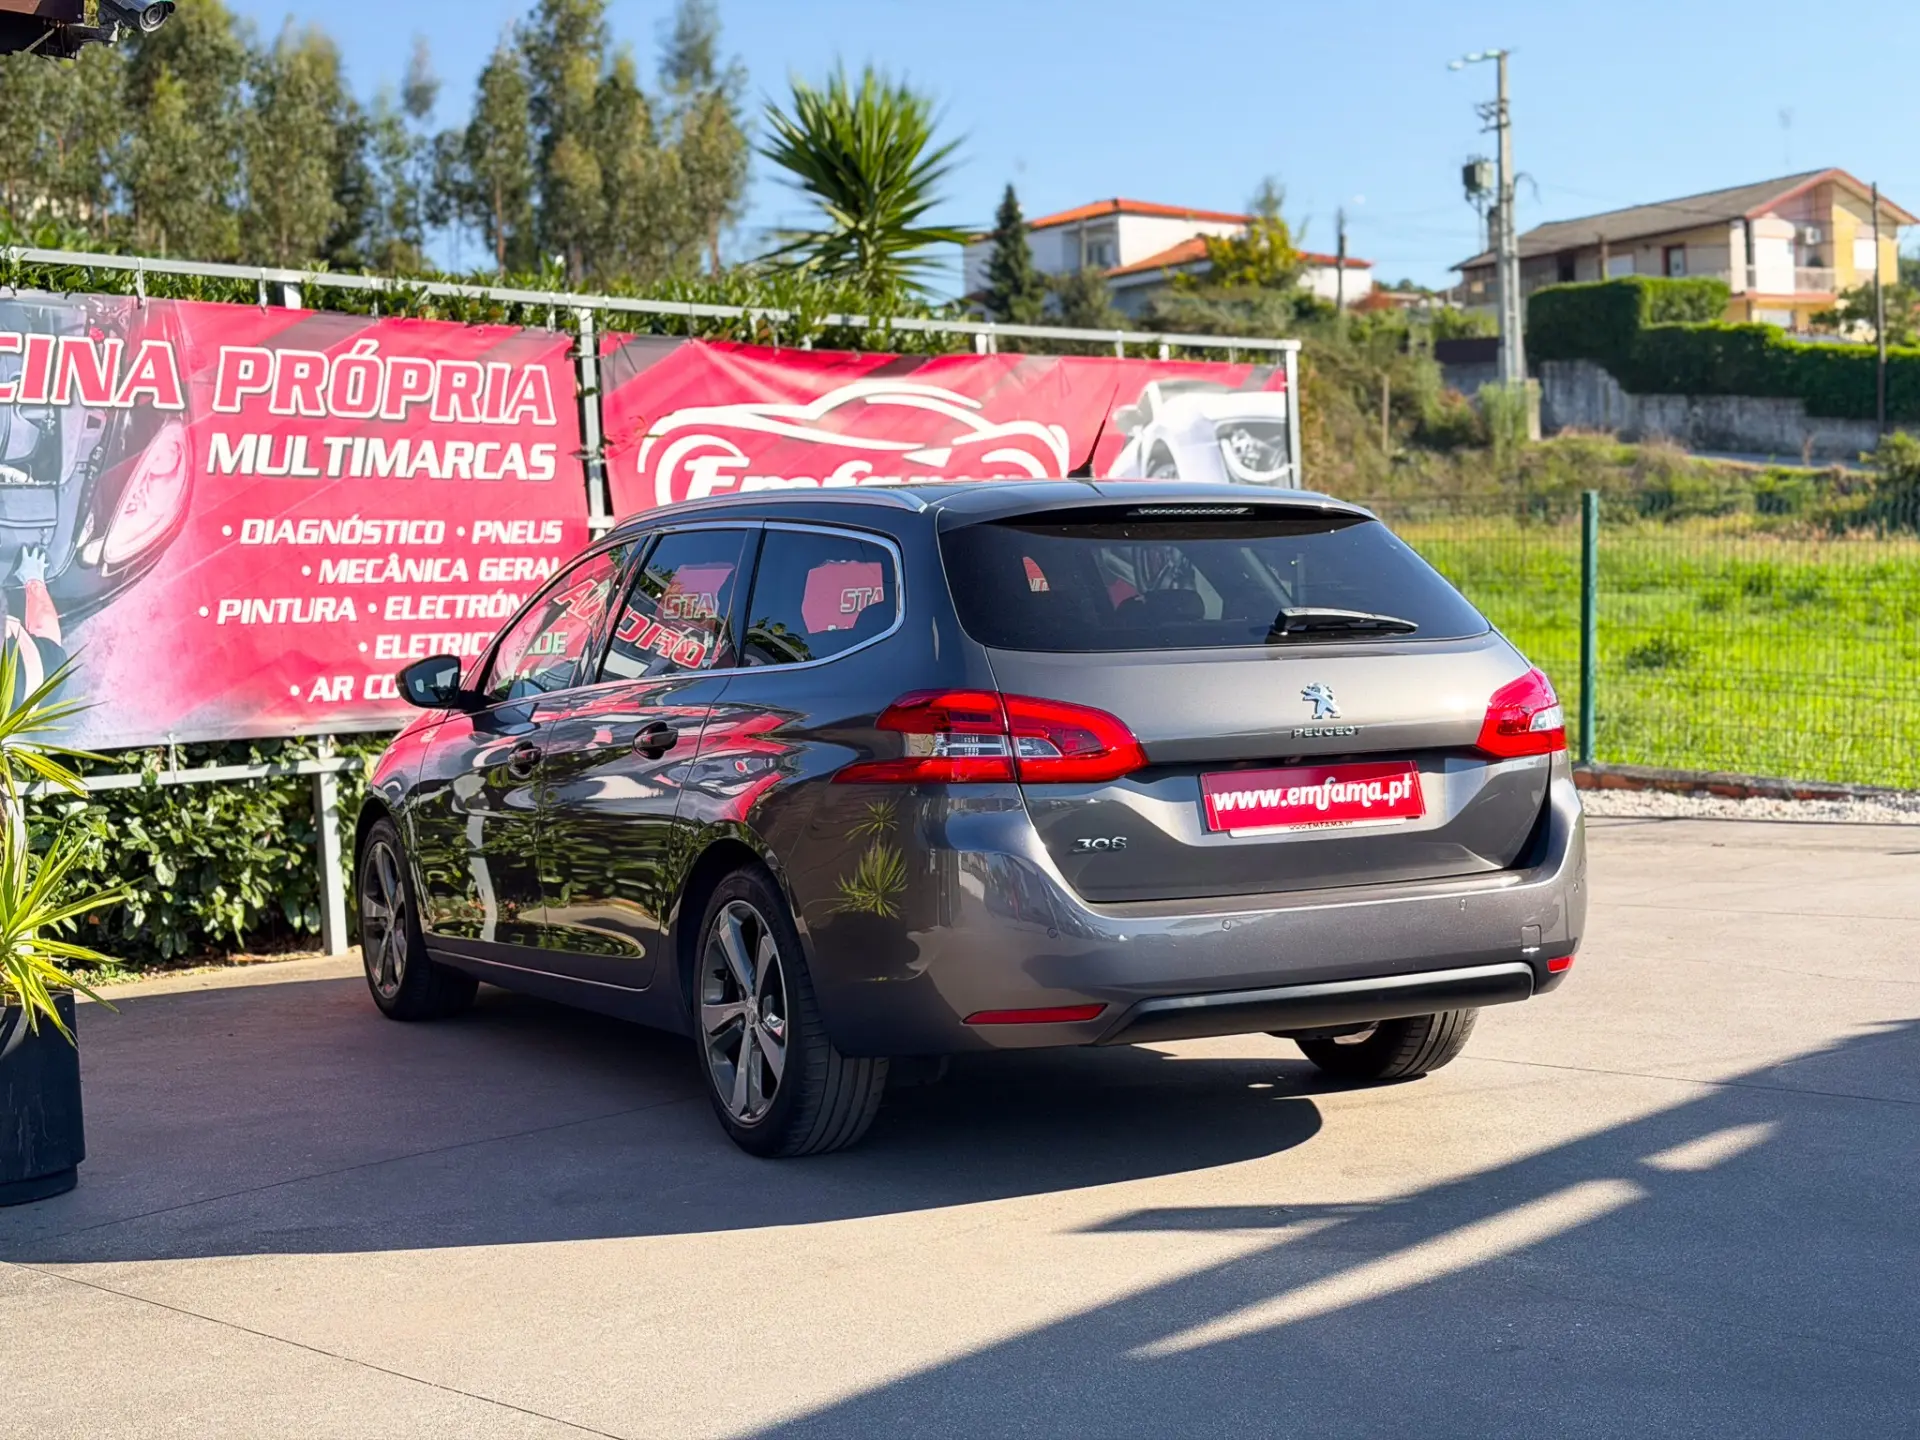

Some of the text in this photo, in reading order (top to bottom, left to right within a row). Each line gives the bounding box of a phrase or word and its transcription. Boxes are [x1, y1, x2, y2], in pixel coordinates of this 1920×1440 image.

[212, 338, 558, 425] PRÓPRIA
[206, 432, 558, 482] MULTIMARCAS
[240, 514, 565, 546] DIAGNÓSTICO PNEUS
[318, 553, 471, 585] MECÂNICA
[216, 597, 359, 626] PINTURA
[307, 675, 355, 703] AR
[1290, 724, 1364, 739] PEUGEOT
[1213, 773, 1413, 812] www.emfama.pt
